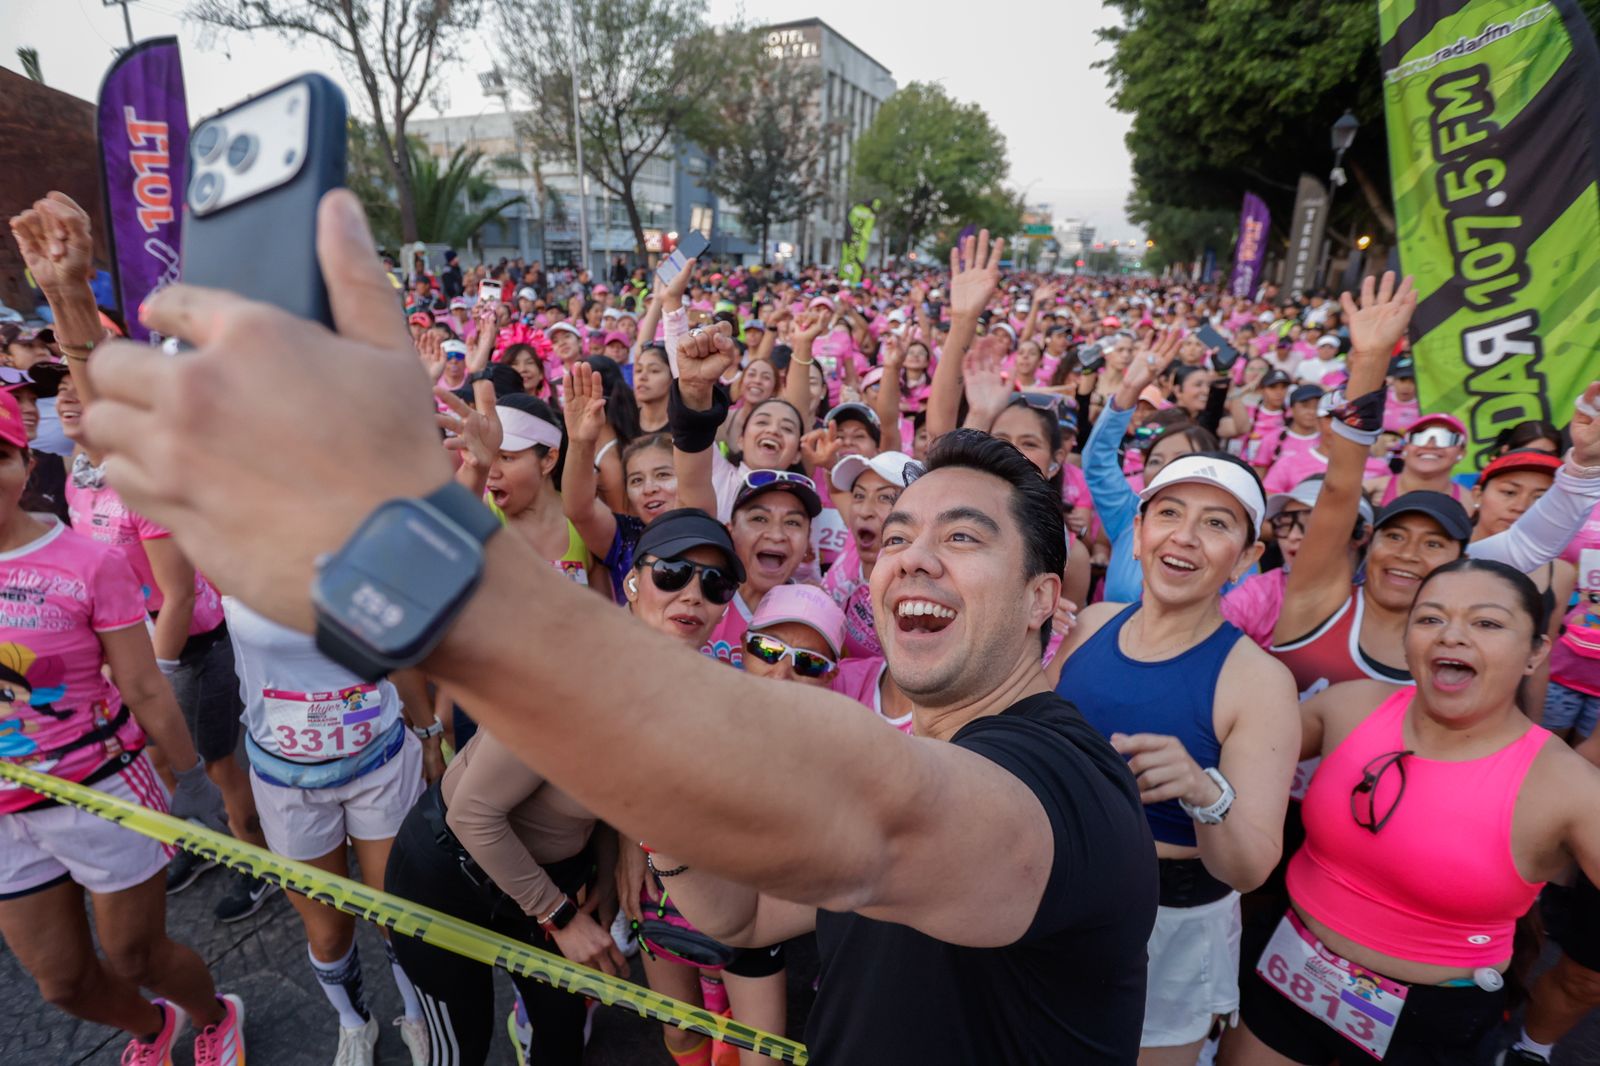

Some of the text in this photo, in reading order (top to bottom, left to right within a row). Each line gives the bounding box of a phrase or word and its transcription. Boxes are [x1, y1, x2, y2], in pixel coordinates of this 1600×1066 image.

[1433, 72, 1490, 156] FM
[1444, 157, 1523, 306] 107.5
[276, 721, 373, 753] 3313
[1267, 953, 1377, 1041] 6813
